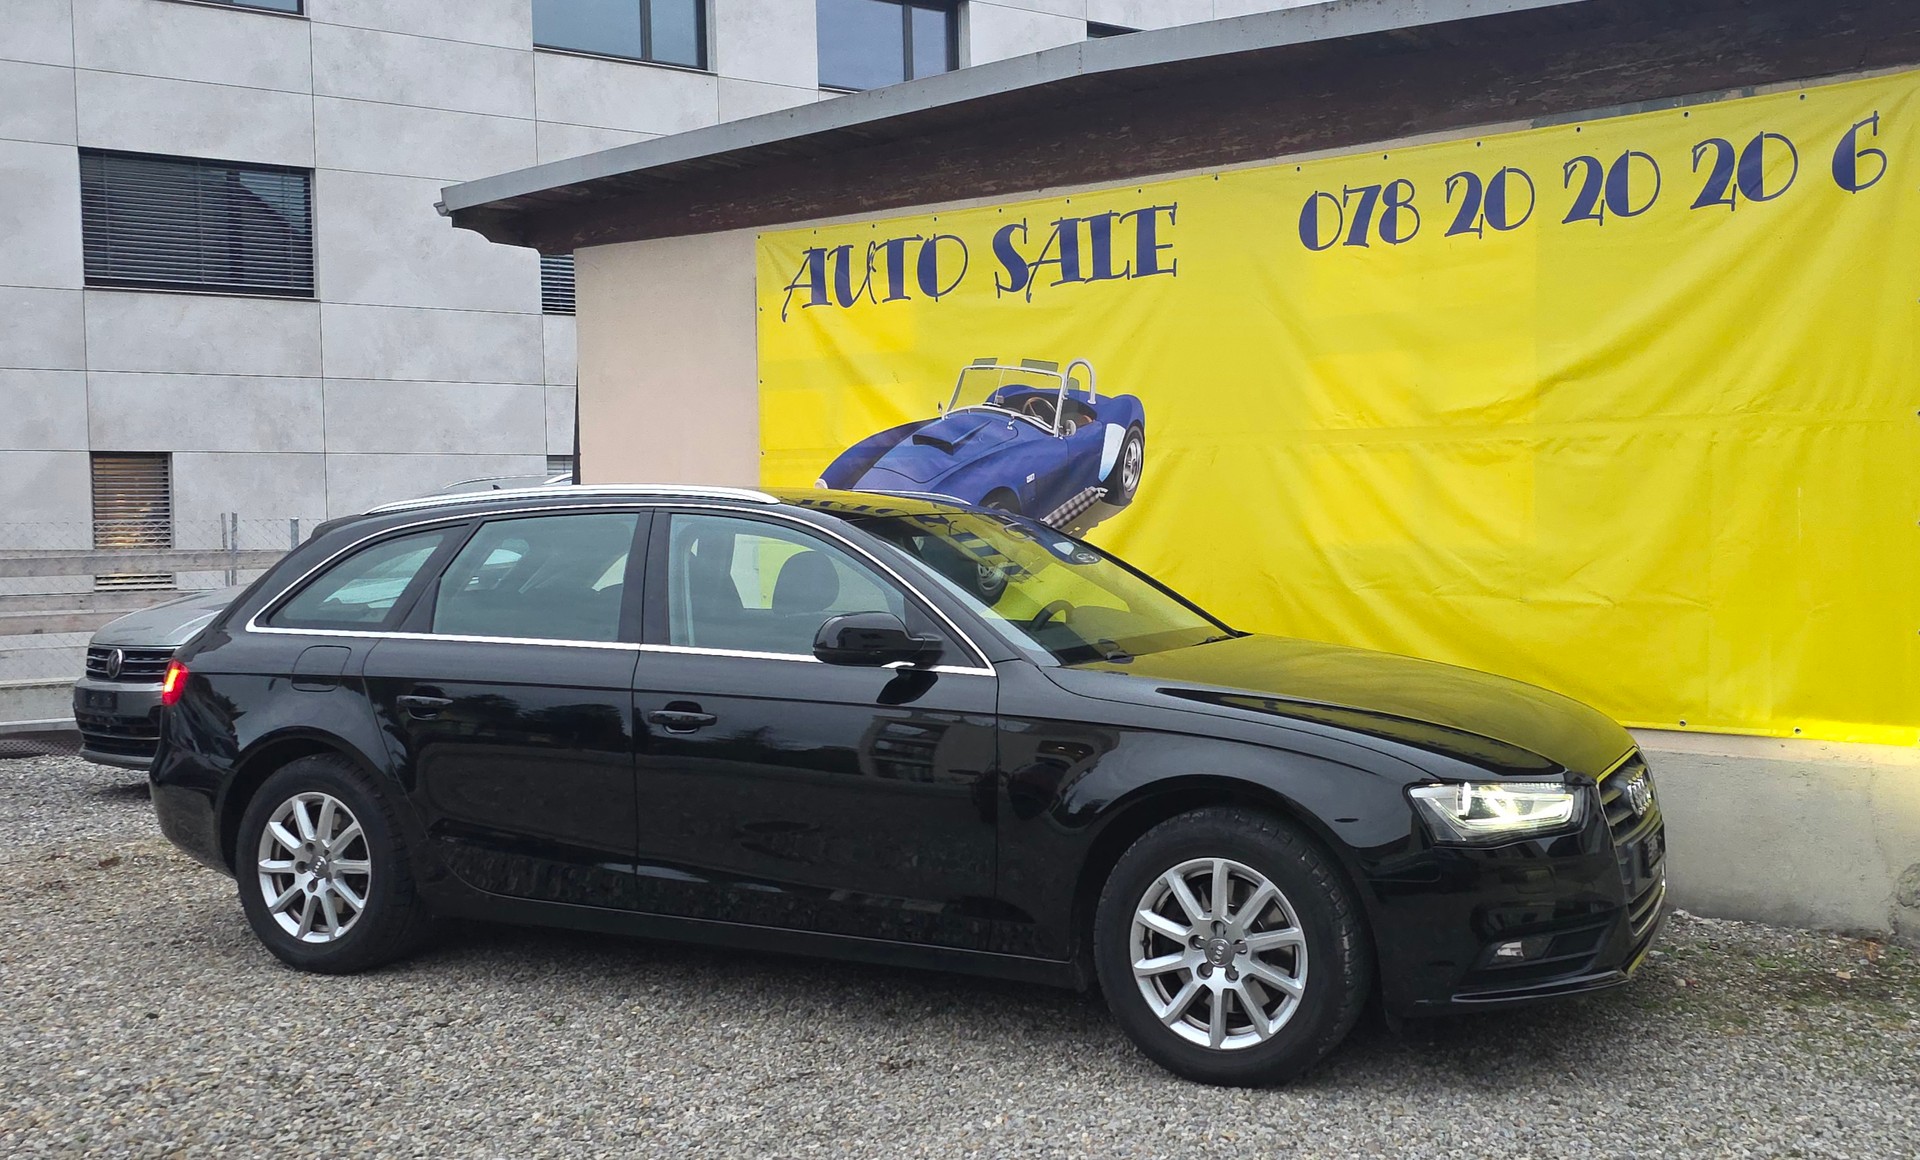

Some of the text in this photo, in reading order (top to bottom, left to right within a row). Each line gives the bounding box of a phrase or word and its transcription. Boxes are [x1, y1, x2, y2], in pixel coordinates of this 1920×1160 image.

[1298, 110, 1888, 251] 078 20 20 20 6
[782, 202, 1178, 322] AUTO SALE
